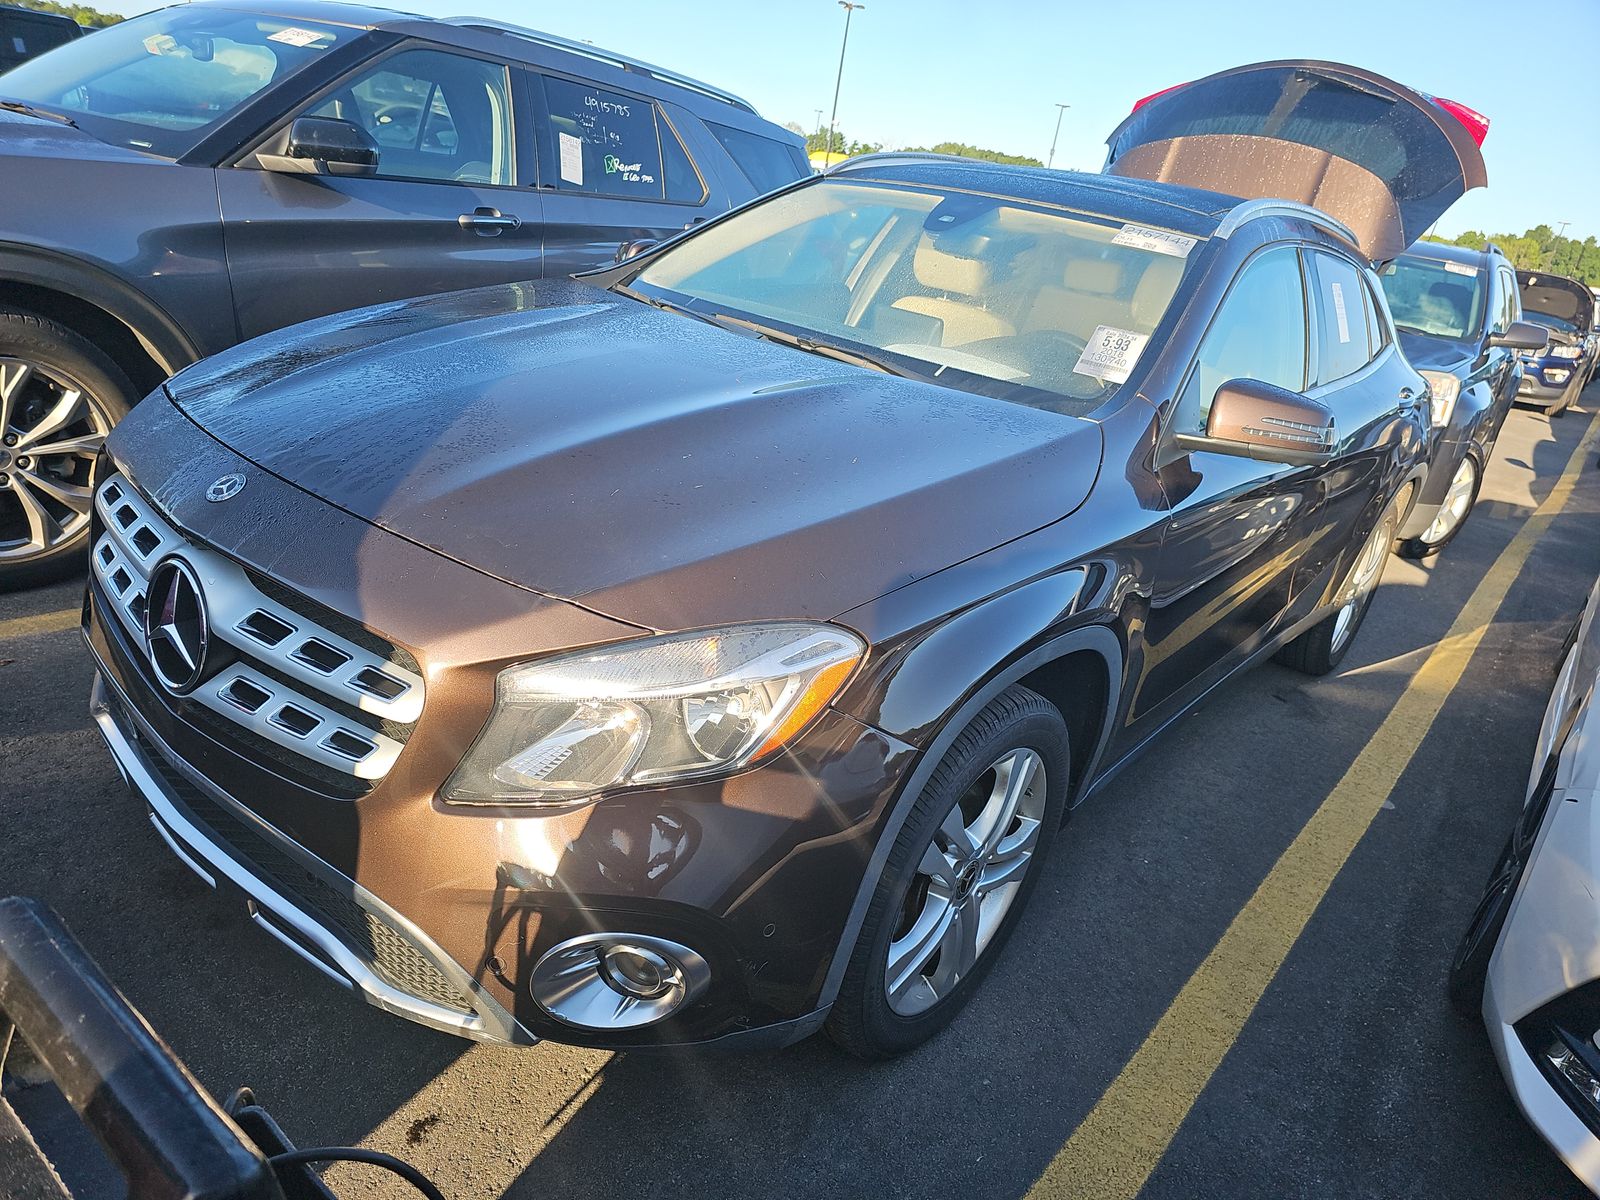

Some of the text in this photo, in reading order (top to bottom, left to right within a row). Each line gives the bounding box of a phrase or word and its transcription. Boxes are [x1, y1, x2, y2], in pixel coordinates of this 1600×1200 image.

[584, 96, 631, 117] 4915785
[1124, 227, 1191, 247] 2157144
[1102, 335, 1131, 351] 5:93
[1100, 348, 1124, 358] 2018
